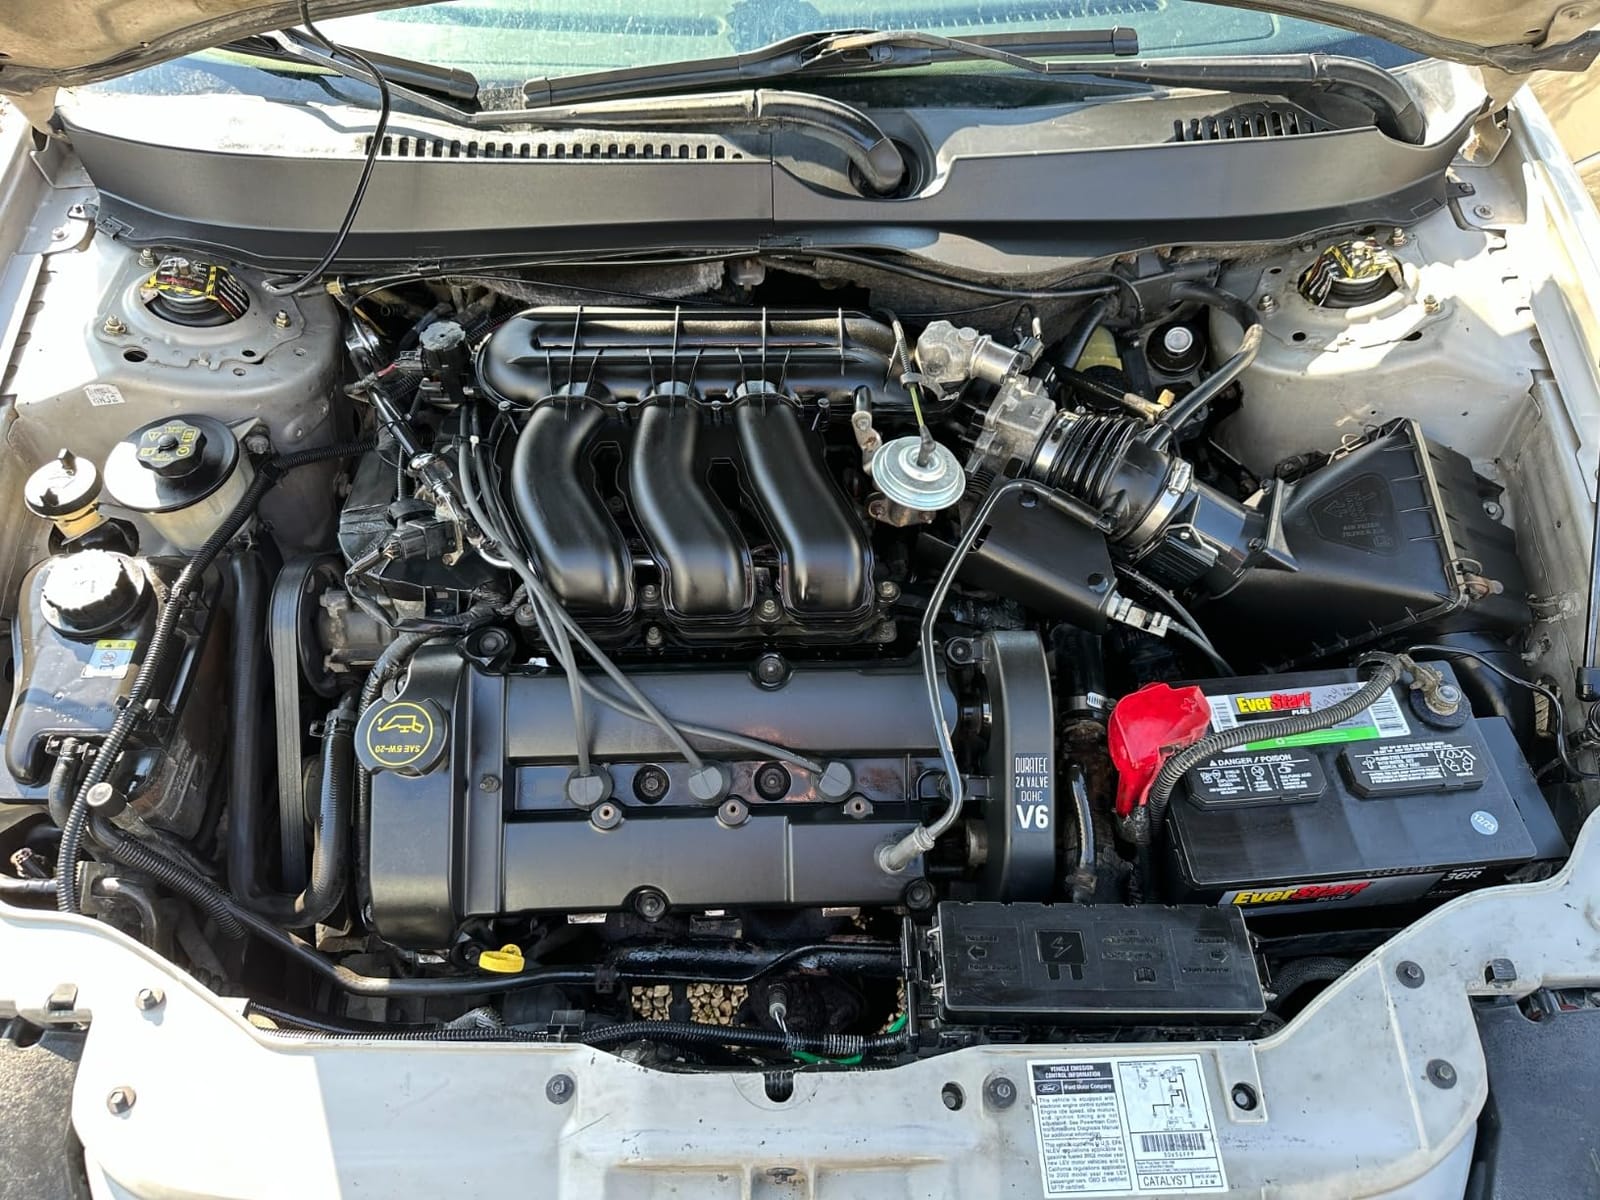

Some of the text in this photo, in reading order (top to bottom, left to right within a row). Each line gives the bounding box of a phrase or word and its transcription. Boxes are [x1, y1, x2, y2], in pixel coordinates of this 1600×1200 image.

[1236, 692, 1312, 713] EverStart
[375, 745, 421, 753] SAE 5W-20
[1015, 758, 1048, 773] DURATEC
[1218, 758, 1253, 766] DANGER
[1260, 754, 1292, 762] POISON
[1015, 776, 1048, 788] 24 VALVE
[1021, 790, 1043, 802] DOHC
[1016, 804, 1048, 829] V6
[1442, 870, 1482, 881] 36R
[1232, 881, 1371, 904] EverStart
[1144, 1175, 1187, 1187] CATALYST
